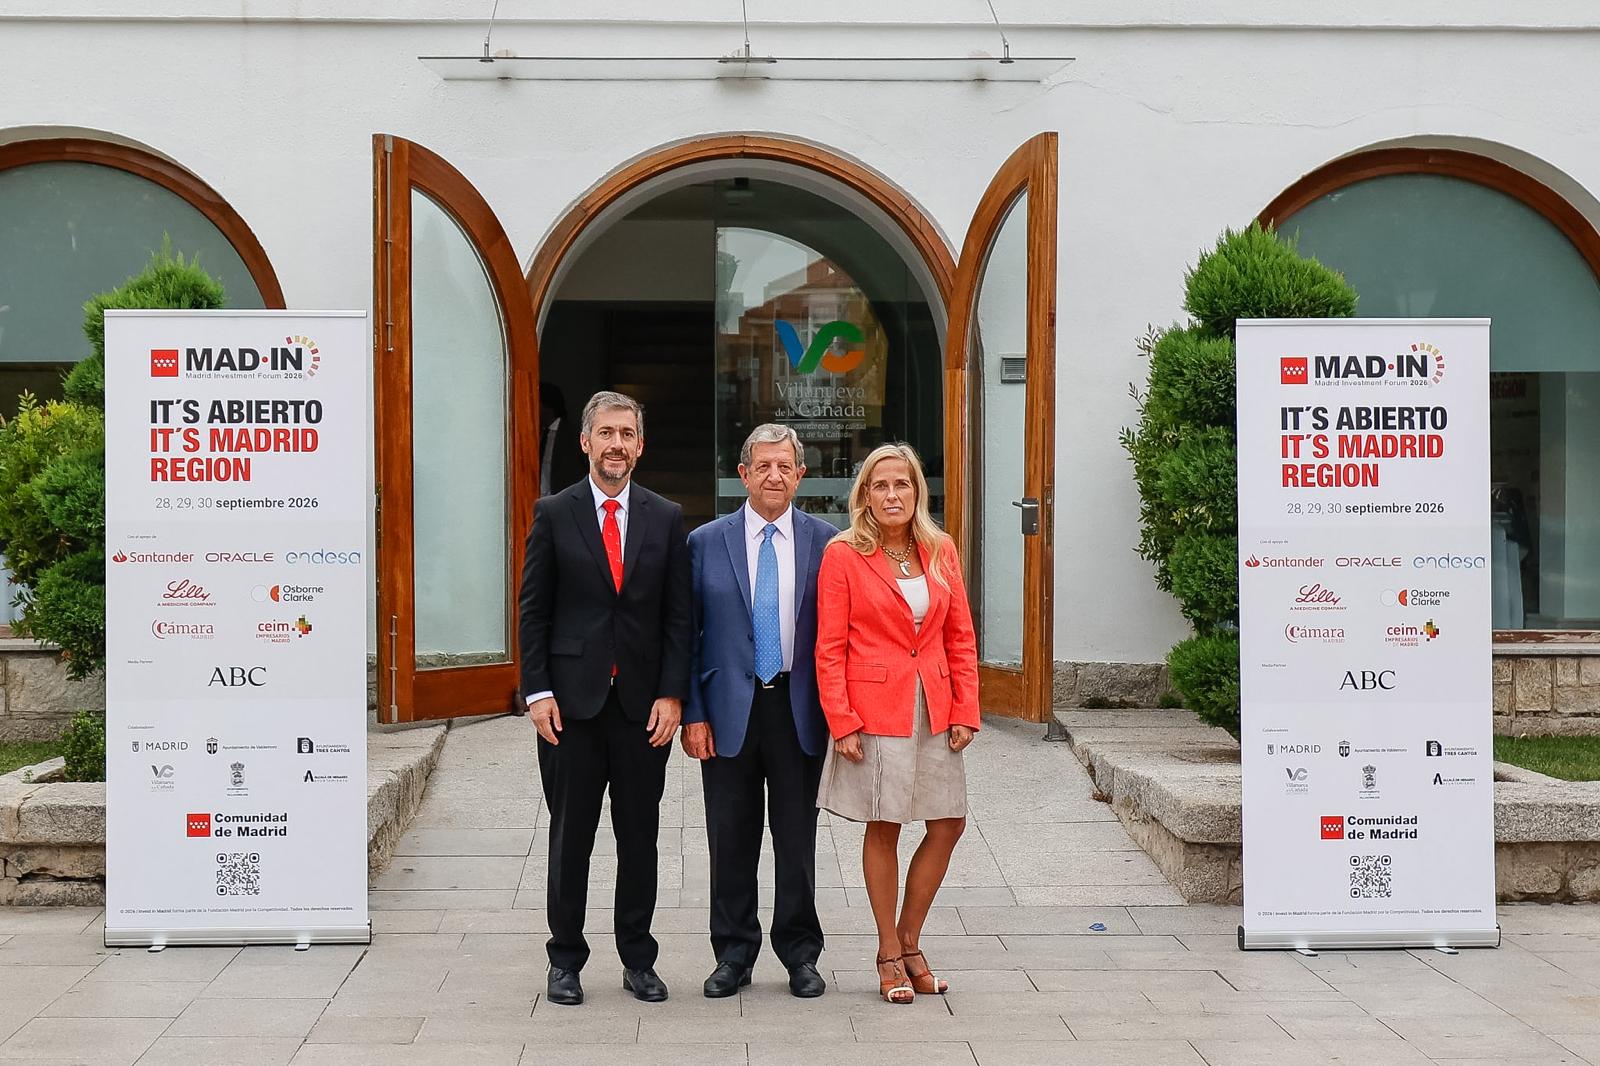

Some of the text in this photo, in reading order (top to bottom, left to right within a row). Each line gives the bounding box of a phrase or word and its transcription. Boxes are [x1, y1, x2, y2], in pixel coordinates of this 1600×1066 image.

[775, 382, 865, 398] Villanueva
[207, 399, 323, 424] ABIERTO
[775, 400, 866, 417] de la Cañada
[1336, 406, 1448, 430] ABIERTO
[209, 428, 319, 453] MADRID
[1338, 434, 1444, 459] MADRID
[151, 457, 251, 482] REGION
[1282, 463, 1379, 488] REGION
[156, 497, 319, 510] 28, 29, 30 septiembre 2026
[1287, 502, 1445, 516] 28, 29, 30 septiembre 2026
[130, 551, 194, 563] Santander
[205, 552, 274, 563] ORACLE
[286, 548, 361, 564] endesa
[1263, 556, 1325, 568] Santander
[1335, 557, 1402, 567] ORACLE
[1413, 553, 1485, 569] endesa
[163, 579, 211, 601] Lilly
[283, 585, 324, 594] Osborne
[1295, 583, 1342, 606] Lilly
[1411, 589, 1450, 598] Osborne
[283, 593, 314, 602] Clarke
[1411, 597, 1441, 606] Clarke
[156, 621, 214, 635] Cámara
[258, 619, 289, 632] ceim
[1289, 625, 1345, 639] Cámara
[1386, 623, 1418, 636] ceim
[207, 666, 267, 688] ABC
[1339, 670, 1396, 691] ABC
[145, 741, 189, 751] MADRID
[1280, 744, 1321, 754] MADRID
[215, 813, 288, 823] Comunidad
[1347, 815, 1418, 825] Comunidad
[215, 826, 288, 837] de Madrid
[1347, 829, 1418, 840] de Madrid
